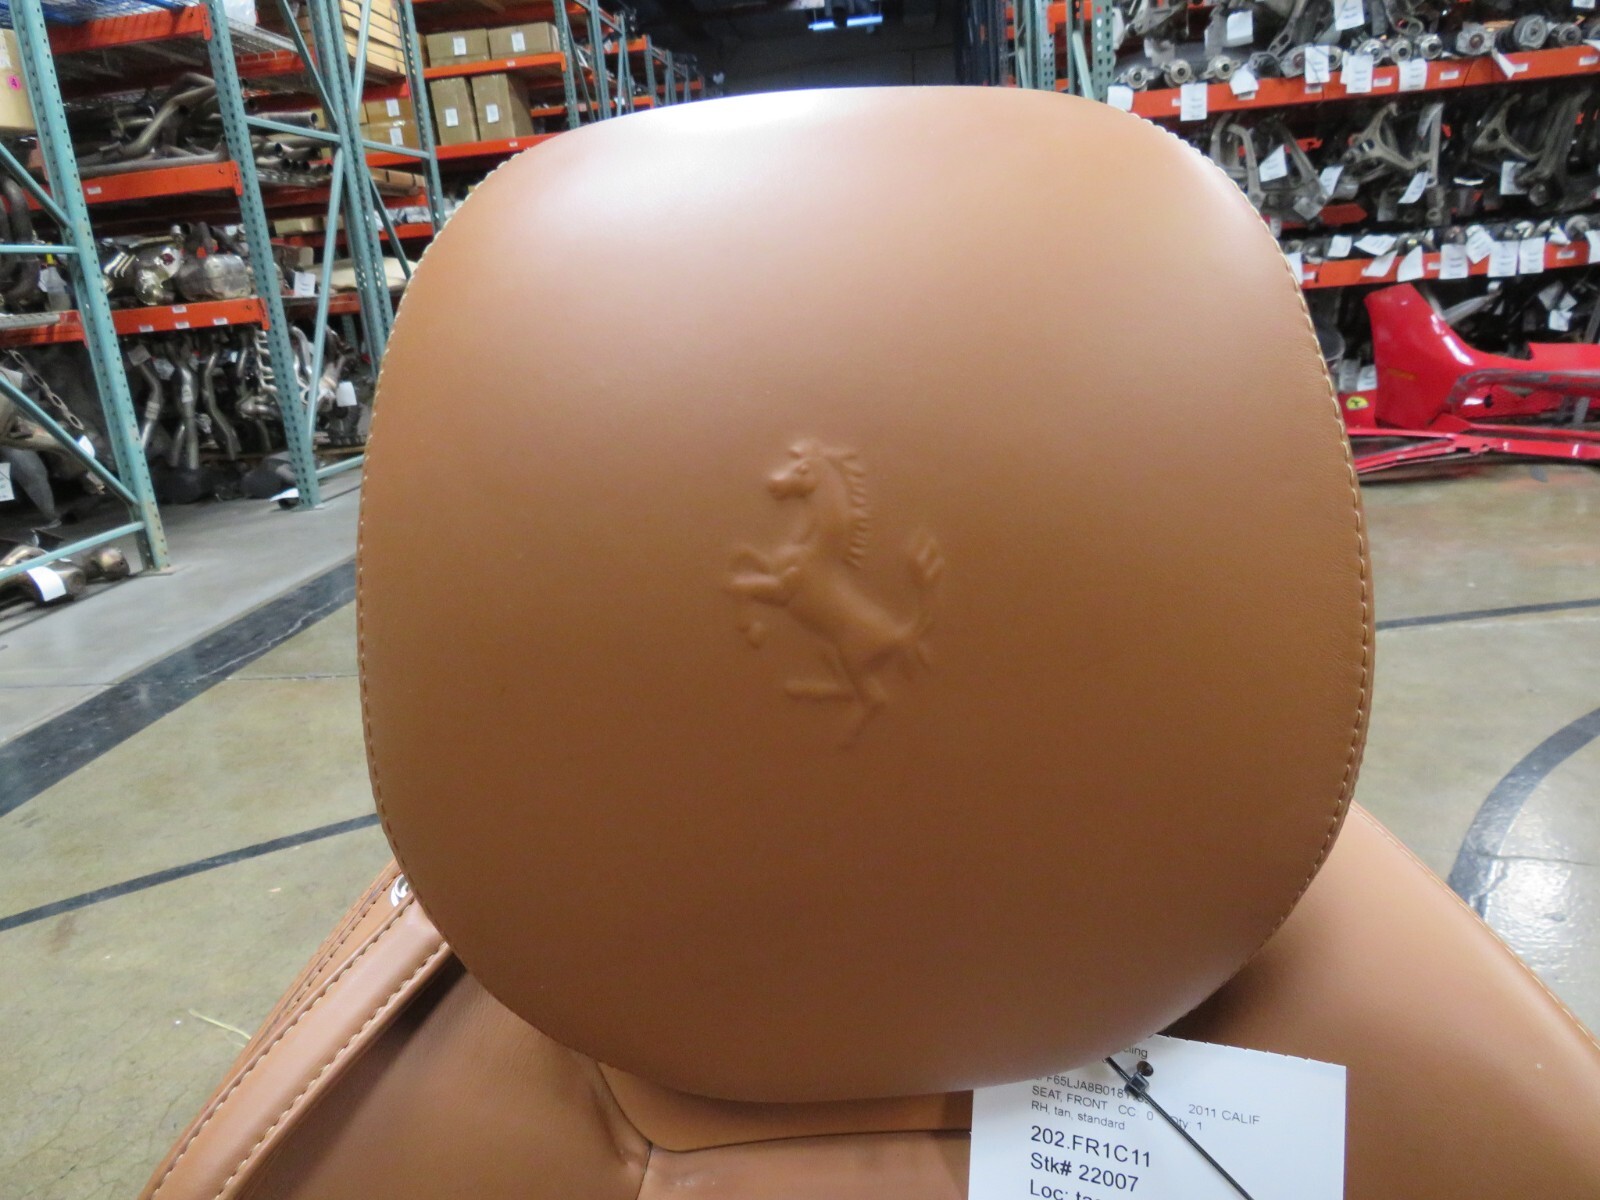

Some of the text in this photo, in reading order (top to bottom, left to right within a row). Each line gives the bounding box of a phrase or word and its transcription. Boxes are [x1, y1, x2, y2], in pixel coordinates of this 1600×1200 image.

[1066, 1093, 1108, 1111] FRONT
[1196, 1121, 1202, 1131] 1
[1077, 1112, 1126, 1131] standard
[1188, 1104, 1216, 1118] 2011
[1221, 1110, 1261, 1125] CALIF
[1030, 1125, 1150, 1168] 202.FR1C11
[1030, 1152, 1139, 1192] Stk# 22007
